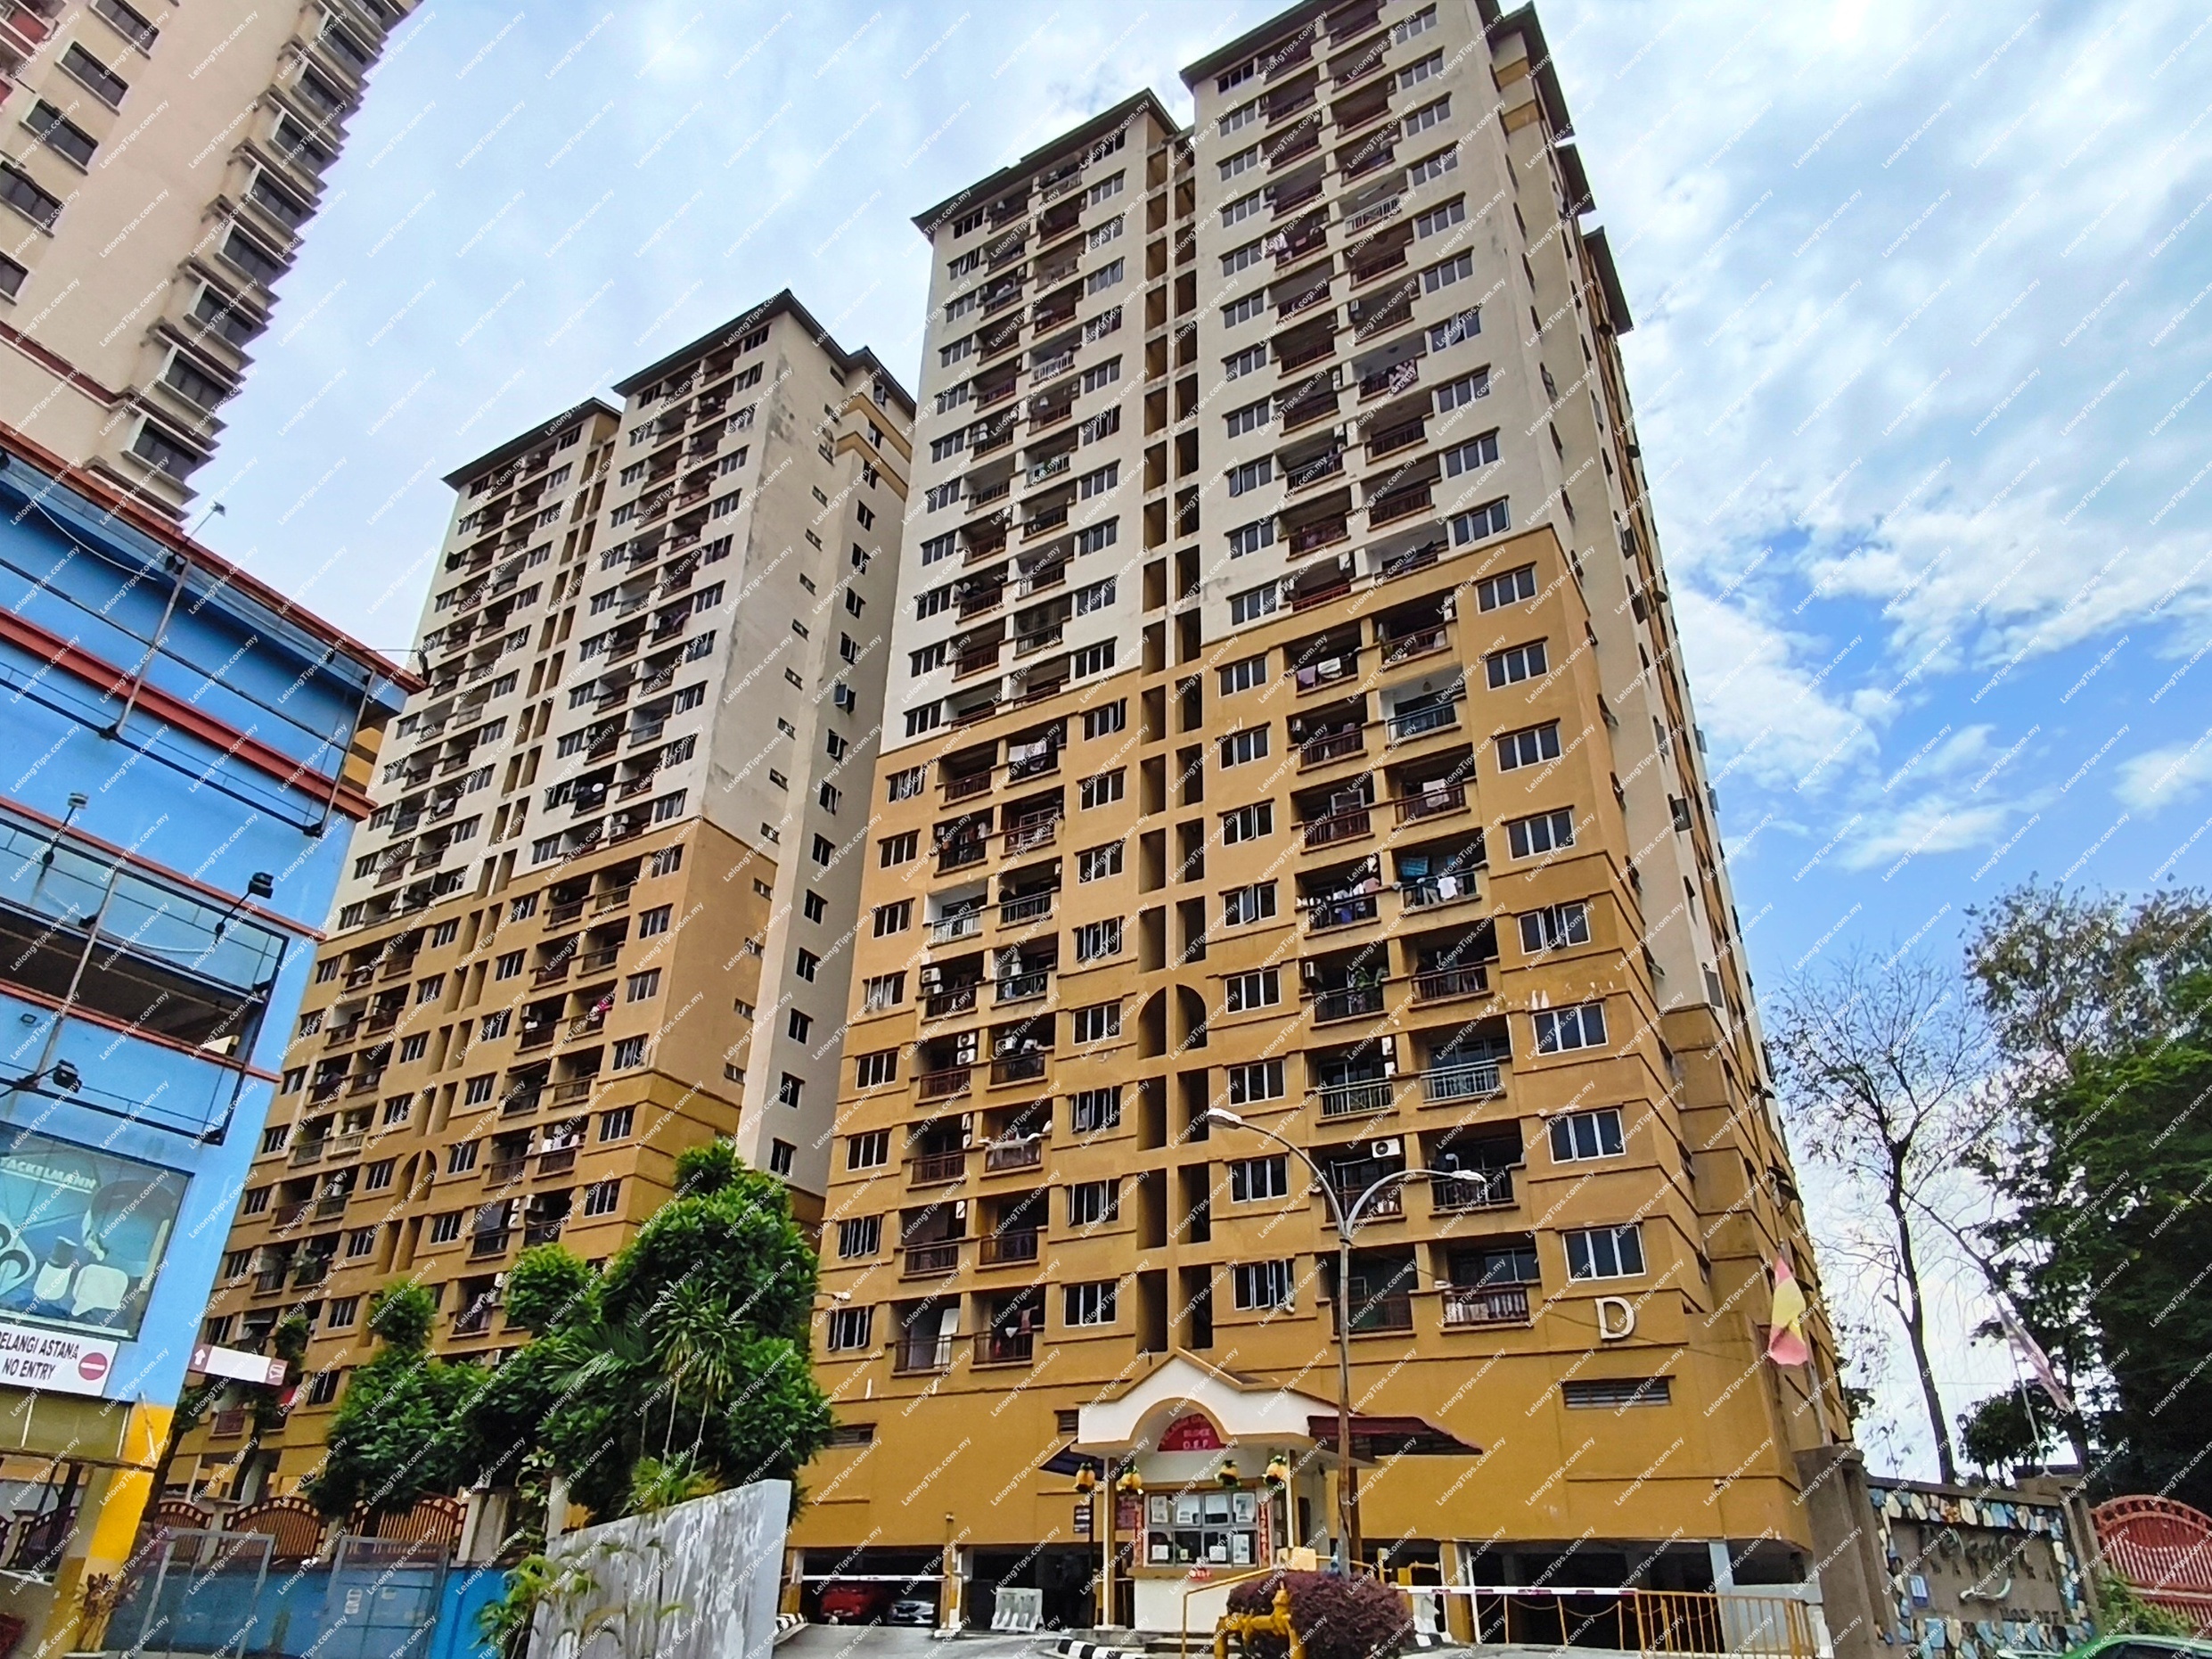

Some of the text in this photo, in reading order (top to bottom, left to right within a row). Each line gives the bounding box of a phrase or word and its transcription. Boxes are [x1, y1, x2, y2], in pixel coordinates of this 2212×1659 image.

[1595, 1296, 1634, 1340] D
[38, 1339, 80, 1360] ASTANA
[2, 1358, 56, 1381] NO ENTRY
